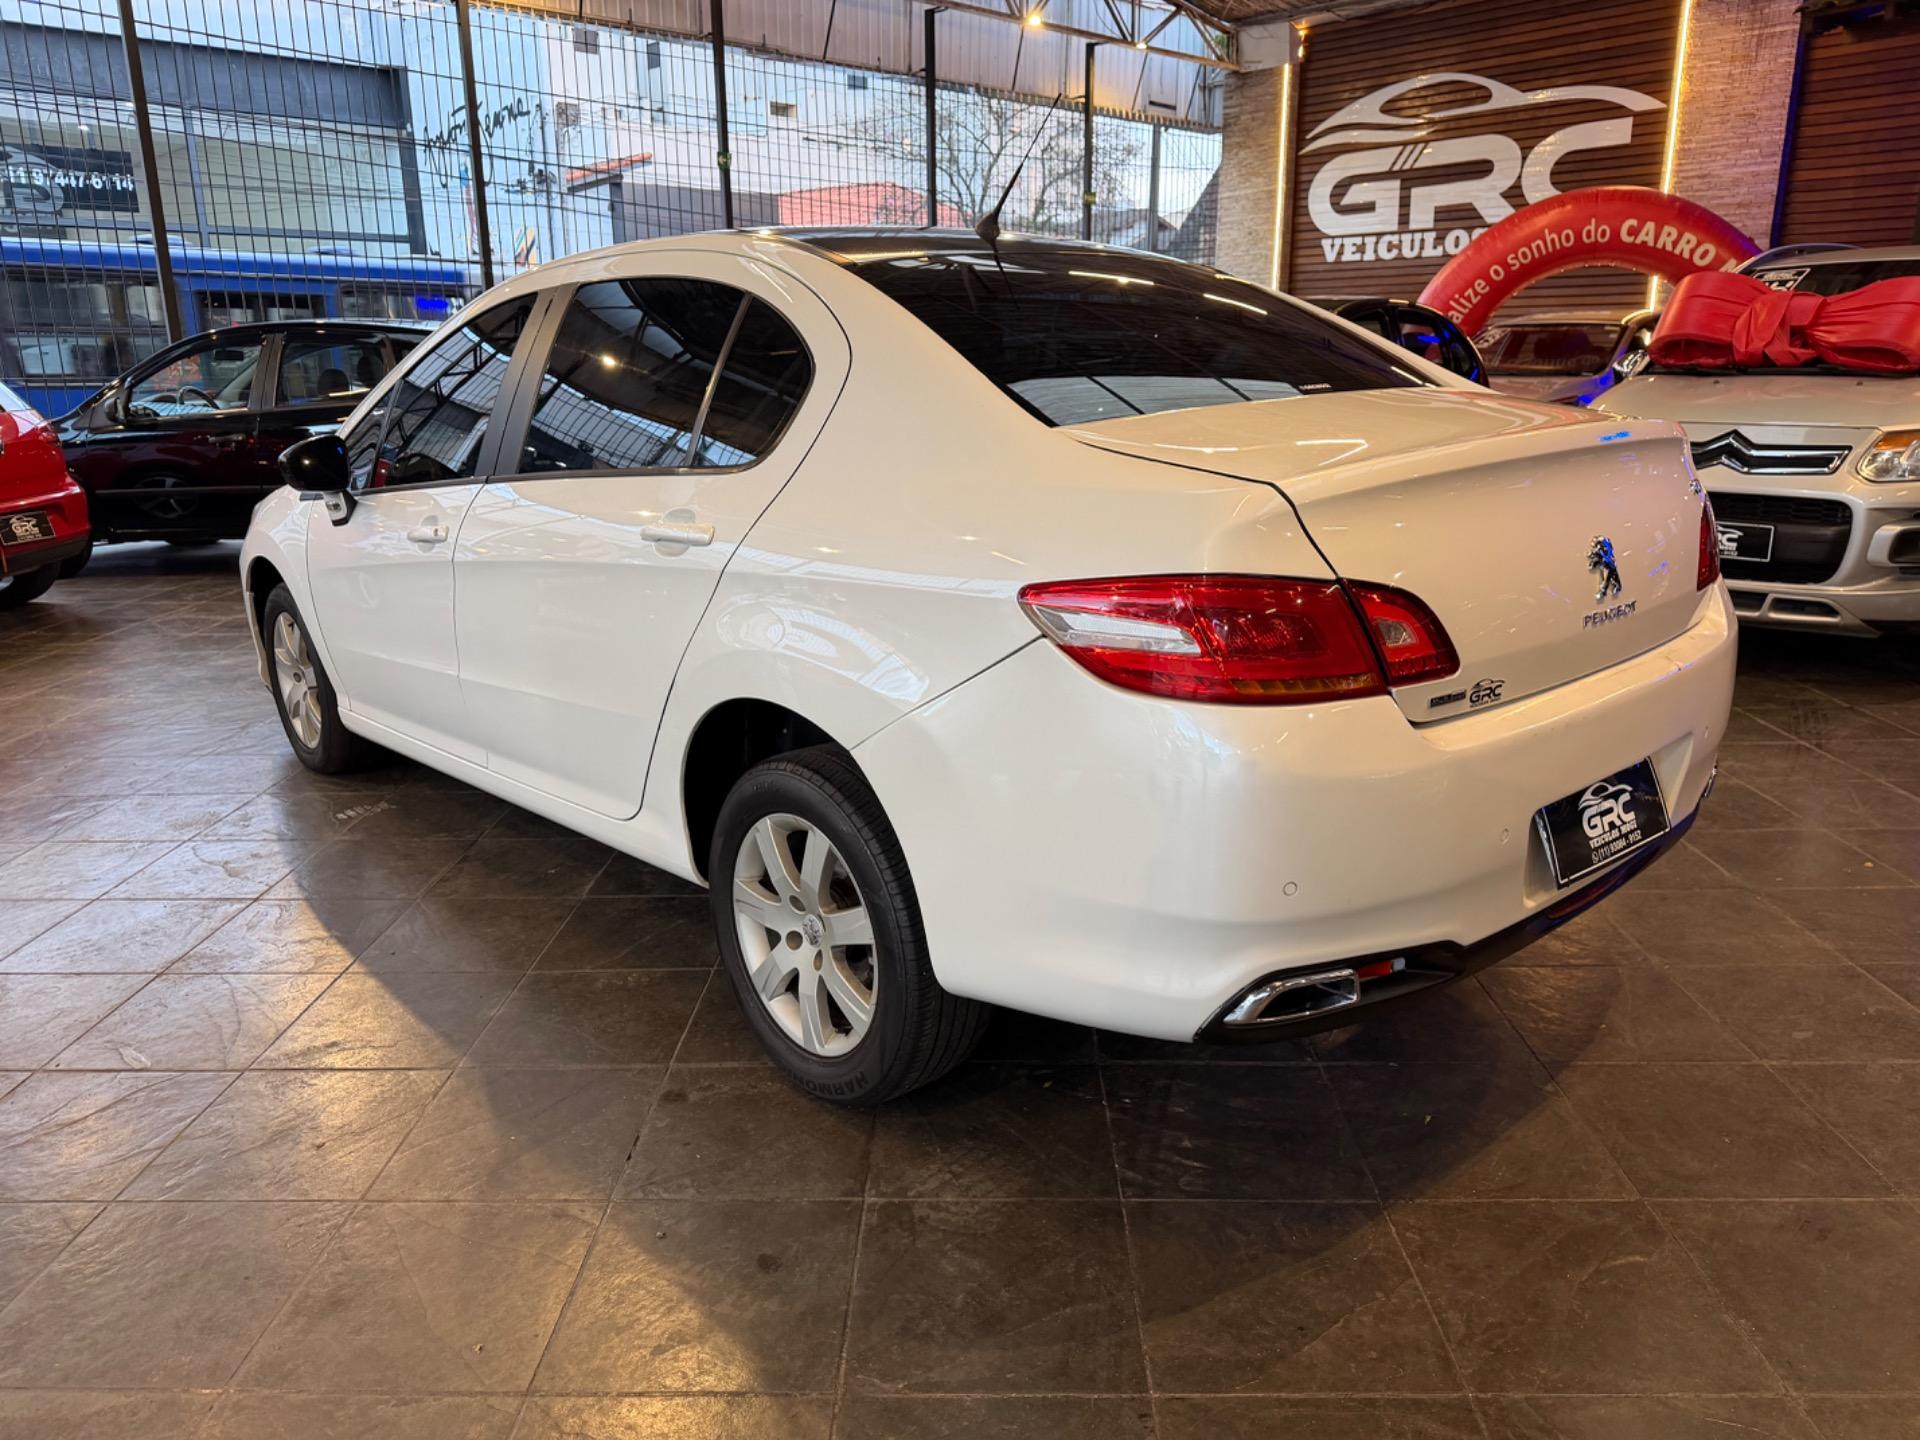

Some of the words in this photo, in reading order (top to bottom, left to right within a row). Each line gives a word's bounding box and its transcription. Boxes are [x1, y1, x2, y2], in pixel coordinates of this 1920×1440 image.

[1308, 116, 1634, 236] GRC
[1447, 277, 1491, 325] alize
[1489, 263, 1506, 282] o
[1507, 228, 1576, 272] sonho
[1582, 217, 1611, 244] do
[1619, 218, 1717, 268] CARRO
[1584, 600, 1637, 628] PEUGEOT
[1470, 684, 1503, 704] GRC
[1582, 791, 1636, 838] GRC
